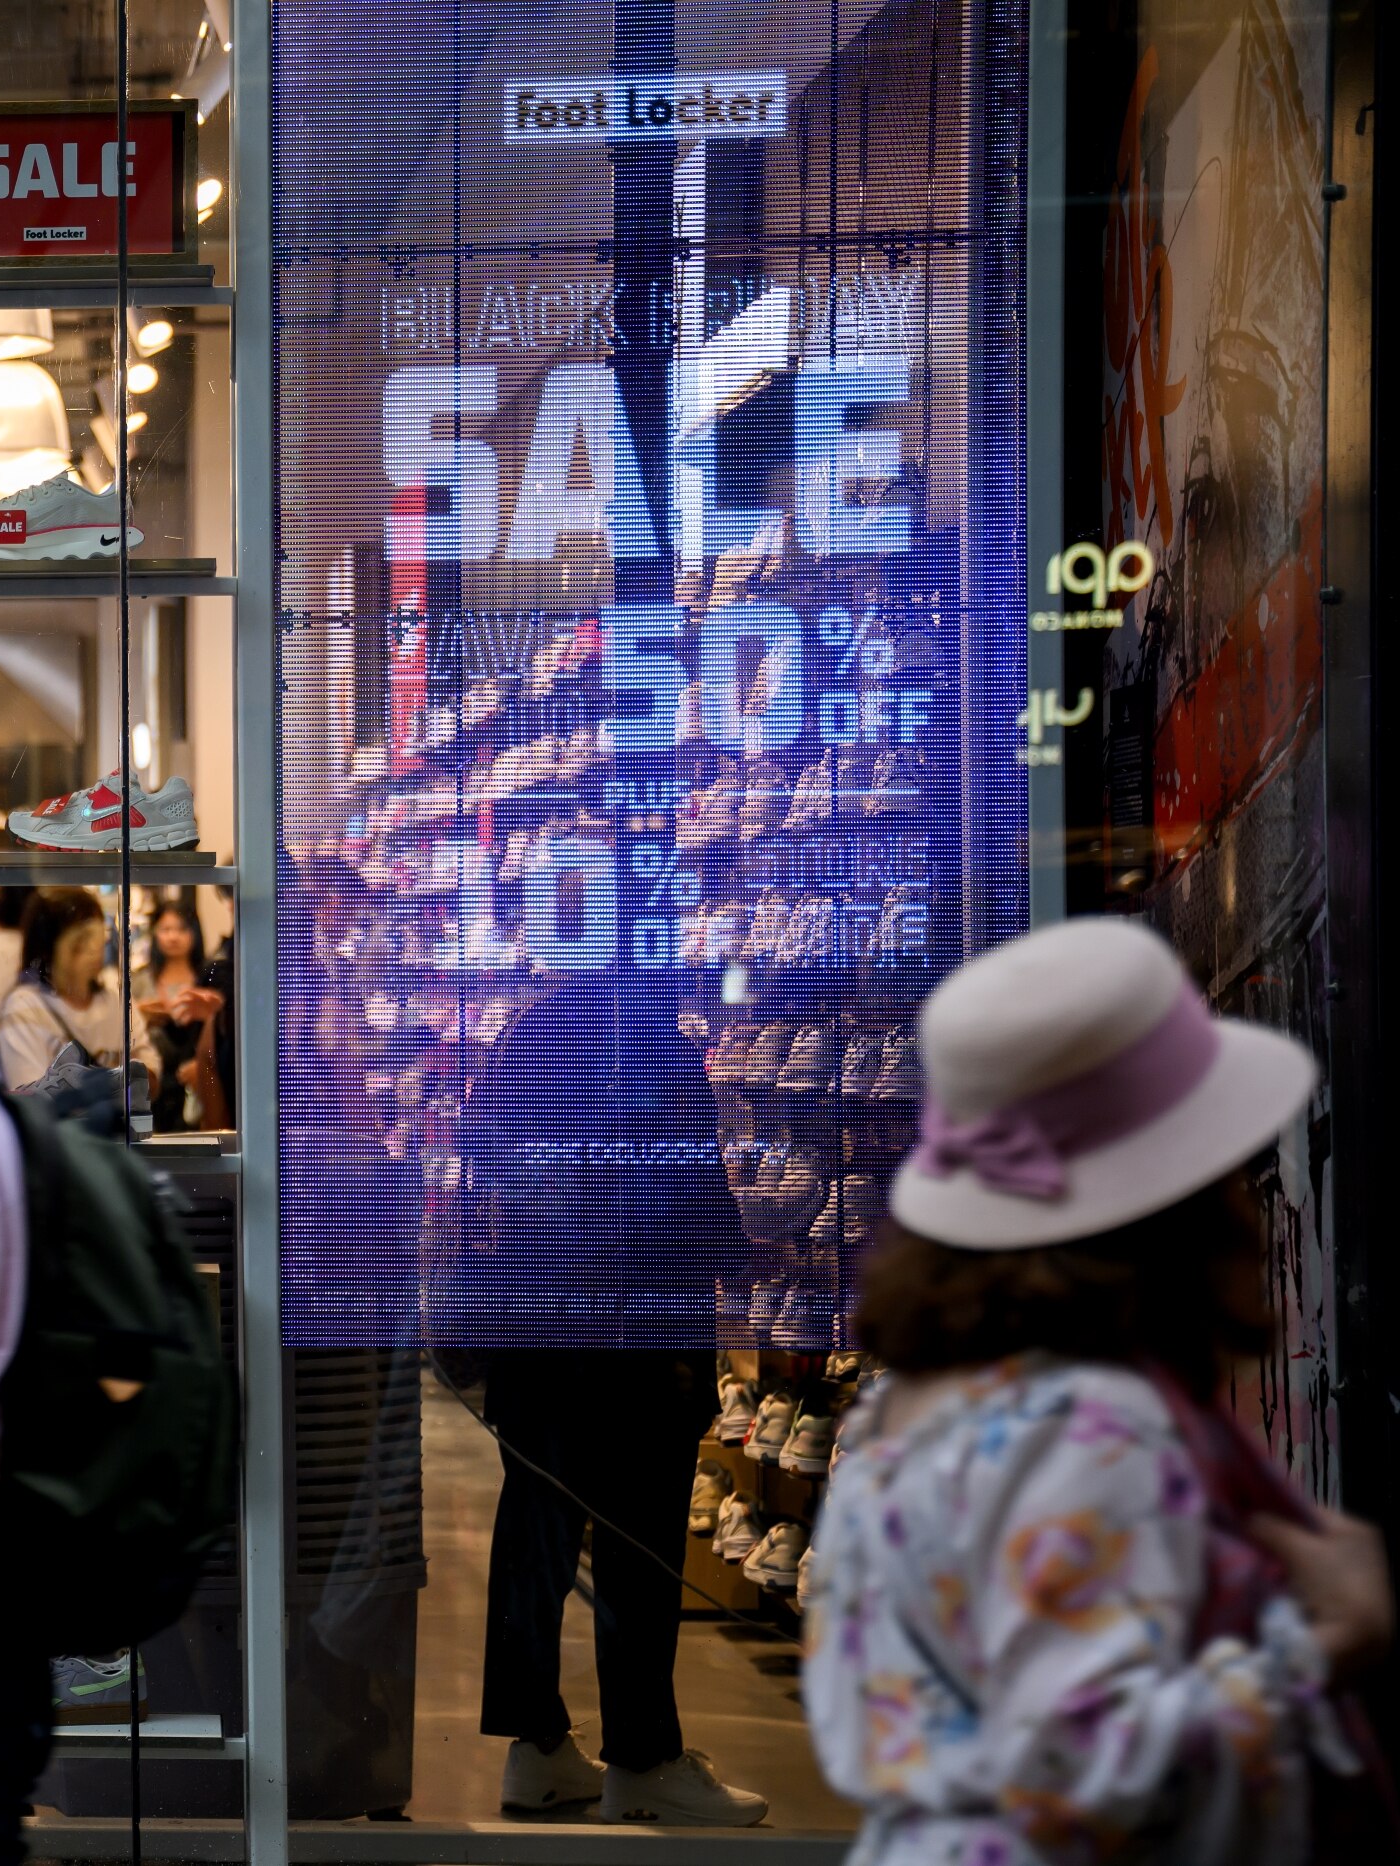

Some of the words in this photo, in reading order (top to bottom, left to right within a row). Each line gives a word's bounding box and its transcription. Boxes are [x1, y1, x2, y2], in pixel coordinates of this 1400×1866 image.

[517, 88, 609, 129] Foot
[627, 82, 775, 126] Locker
[26, 229, 48, 239] Foot
[50, 229, 84, 239] Locker
[379, 280, 632, 354] BLACK
[383, 354, 911, 562] SALE
[819, 689, 932, 745] OFF
